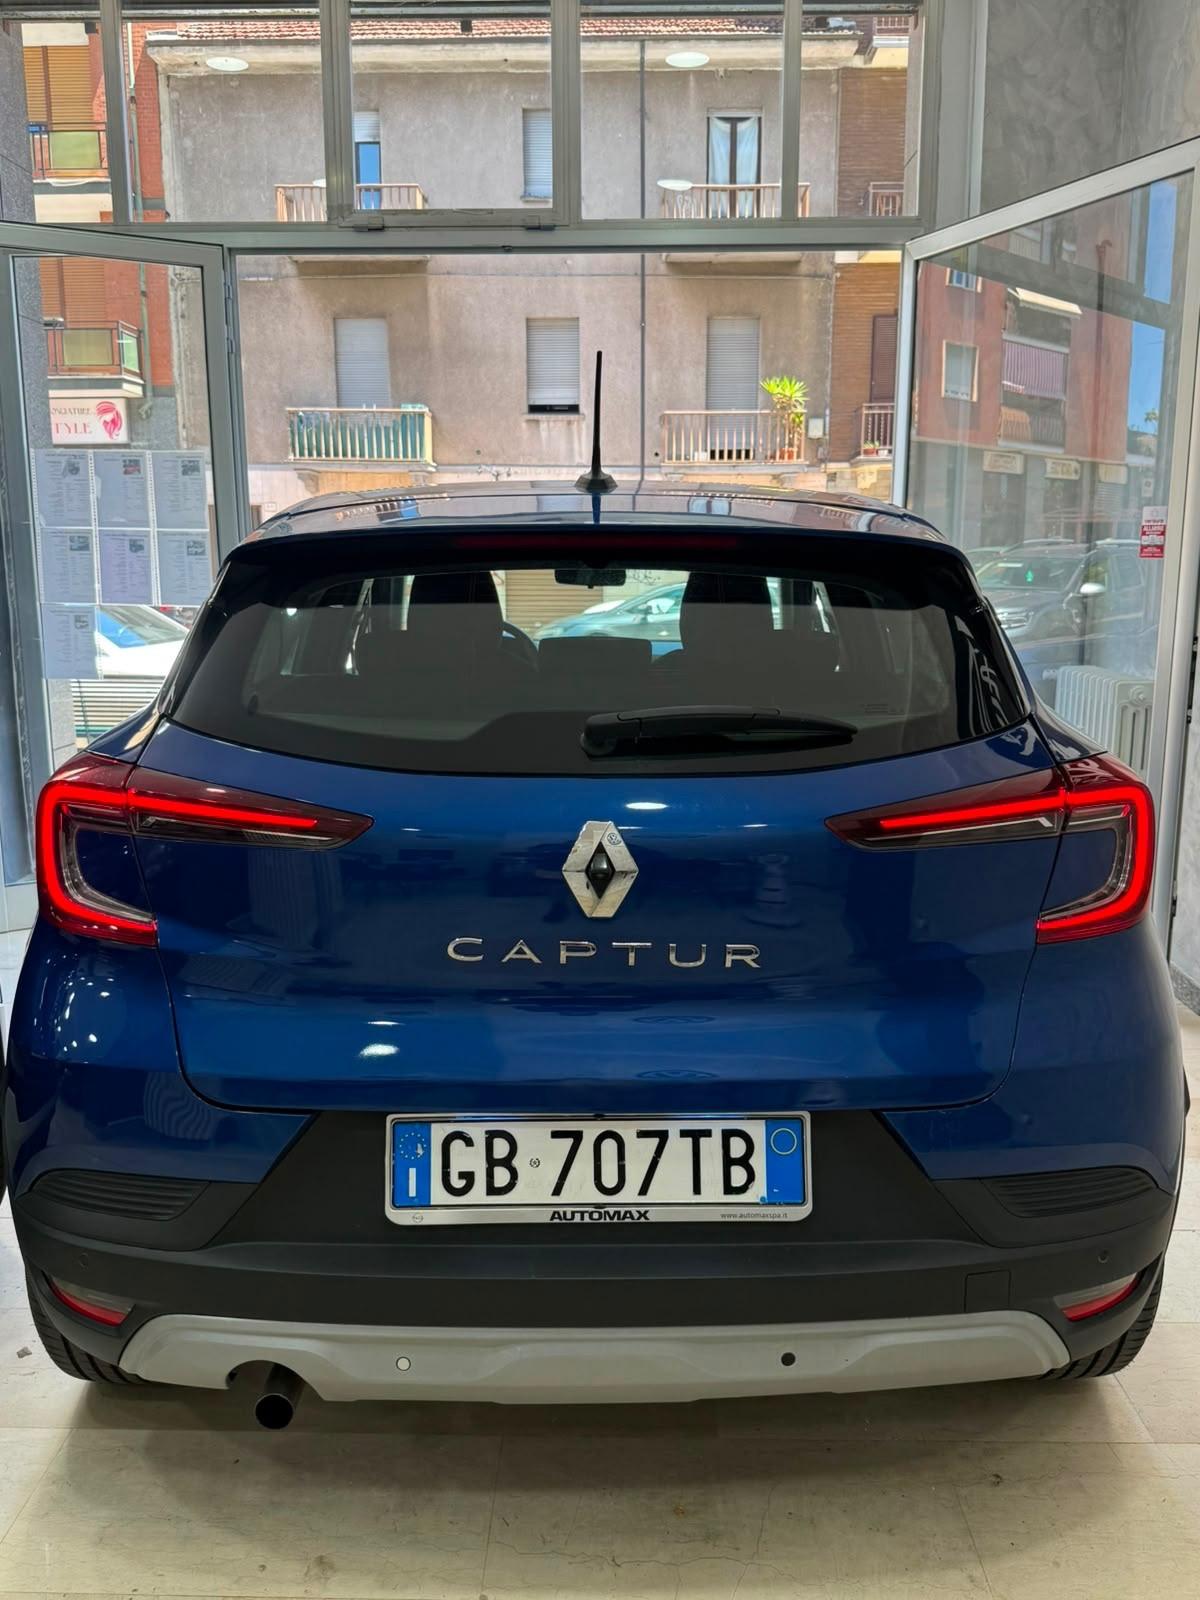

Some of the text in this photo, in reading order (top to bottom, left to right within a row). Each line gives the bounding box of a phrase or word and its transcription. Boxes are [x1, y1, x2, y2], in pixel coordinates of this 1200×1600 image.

[447, 937, 761, 968] CAPTUR
[441, 1128, 756, 1197] GB 707TB
[550, 1210, 650, 1222] AUTOMAX
[720, 1212, 788, 1220] www.automaxspa.it
